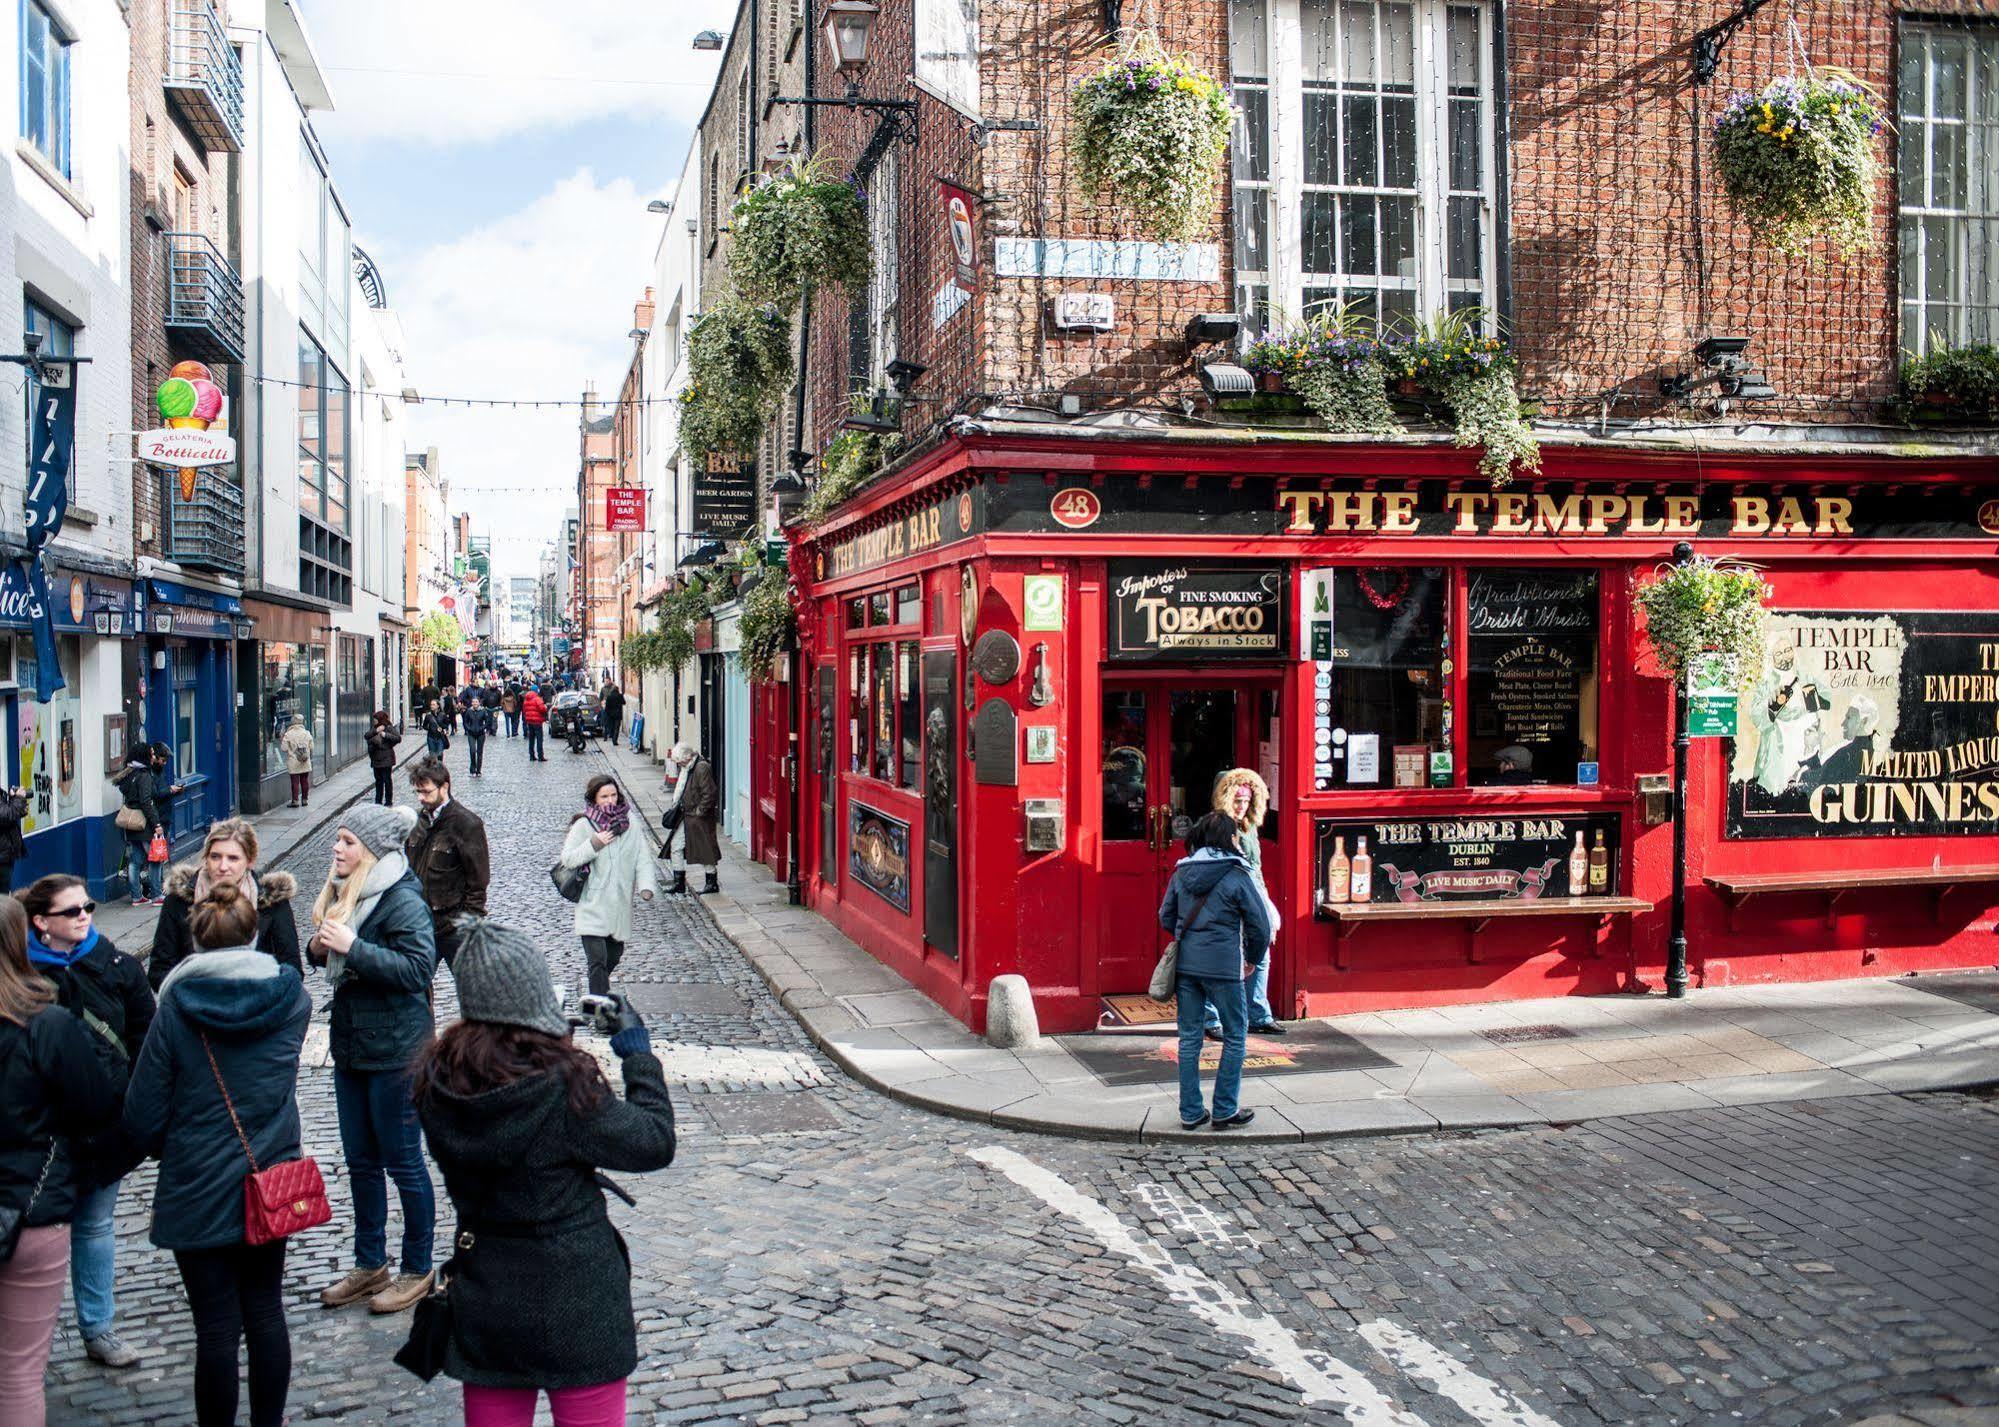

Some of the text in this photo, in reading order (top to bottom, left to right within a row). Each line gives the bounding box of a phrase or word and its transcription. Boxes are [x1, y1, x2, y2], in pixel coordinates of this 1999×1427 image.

[162, 434, 213, 445] GELATERIA
[148, 443, 229, 461] Botticelli
[618, 491, 634, 499] THE
[696, 489, 753, 498] BEER GARDEN
[610, 499, 642, 507] TEMPLE
[1058, 494, 1091, 519] 48
[617, 507, 635, 515] BAR
[699, 513, 749, 522] LIVE MUSIC
[1279, 490, 1856, 537] THE TEMPLE BAR
[711, 520, 738, 528] DAILY
[833, 542, 855, 575] THE
[857, 520, 904, 566] TEMPLE
[909, 506, 942, 551] BAR
[1115, 567, 1188, 599] Importers
[1160, 584, 1175, 595] OF
[1180, 591, 1263, 603] FINE SMOKING
[1469, 573, 1585, 610] Traditional
[1135, 597, 1265, 643] TOBACCO
[1162, 635, 1275, 648] Always in Stock
[1791, 626, 1899, 649] TEMPLE
[1494, 644, 1572, 669] TEMPLE BAR
[1824, 650, 1876, 673] BAR
[1494, 669, 1534, 678] Traditional
[1537, 669, 1555, 678] Food
[1924, 674, 1999, 703] EMPER
[1859, 749, 1942, 779] MALTED
[1375, 819, 1567, 845] THE TEMPLE BAR
[1448, 843, 1495, 856] DUBLIN
[1453, 857, 1490, 866] EST. 1840
[1426, 875, 1515, 888] LIVE MUSIC DAILY
